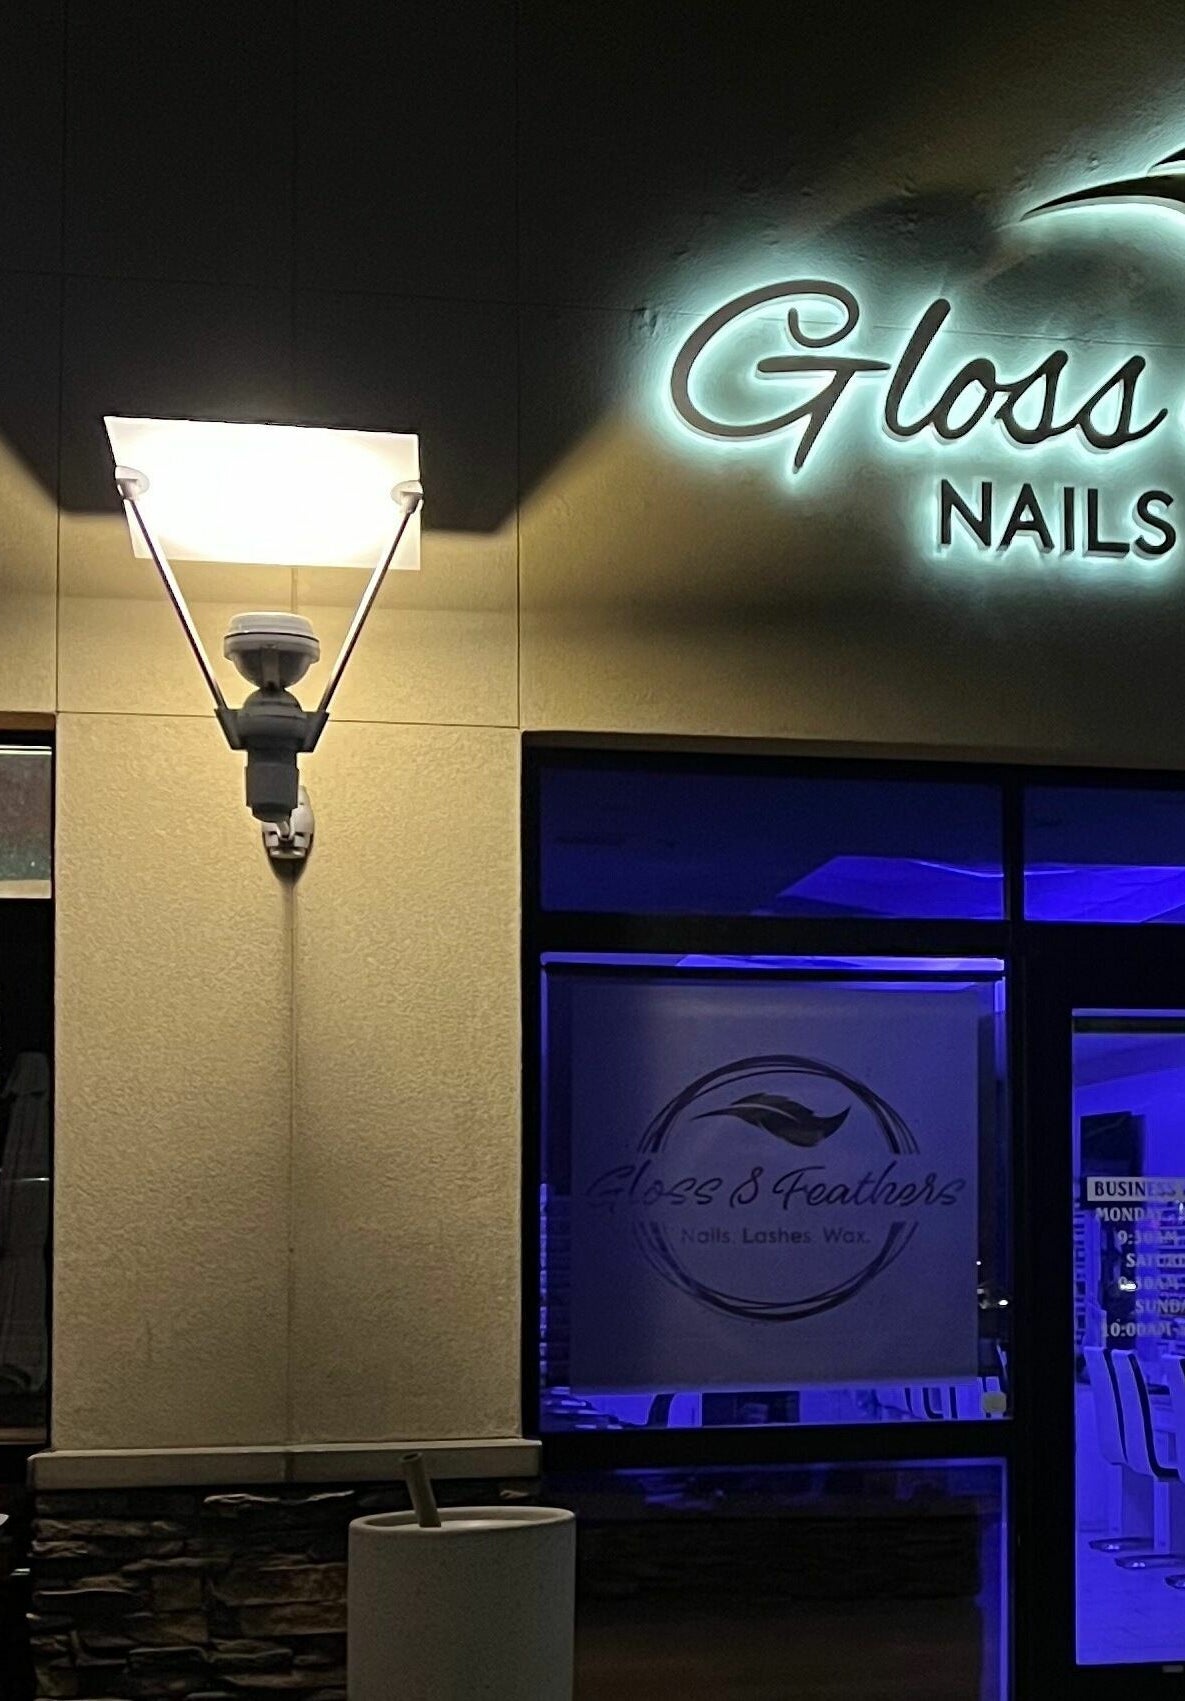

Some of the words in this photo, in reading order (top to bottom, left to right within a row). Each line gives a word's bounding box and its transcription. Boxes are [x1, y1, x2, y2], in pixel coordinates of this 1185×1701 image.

[671, 279, 1167, 474] Gloss
[938, 479, 1177, 559] NAILS
[584, 1159, 723, 1213] Gloss
[772, 1160, 967, 1211] Feathers
